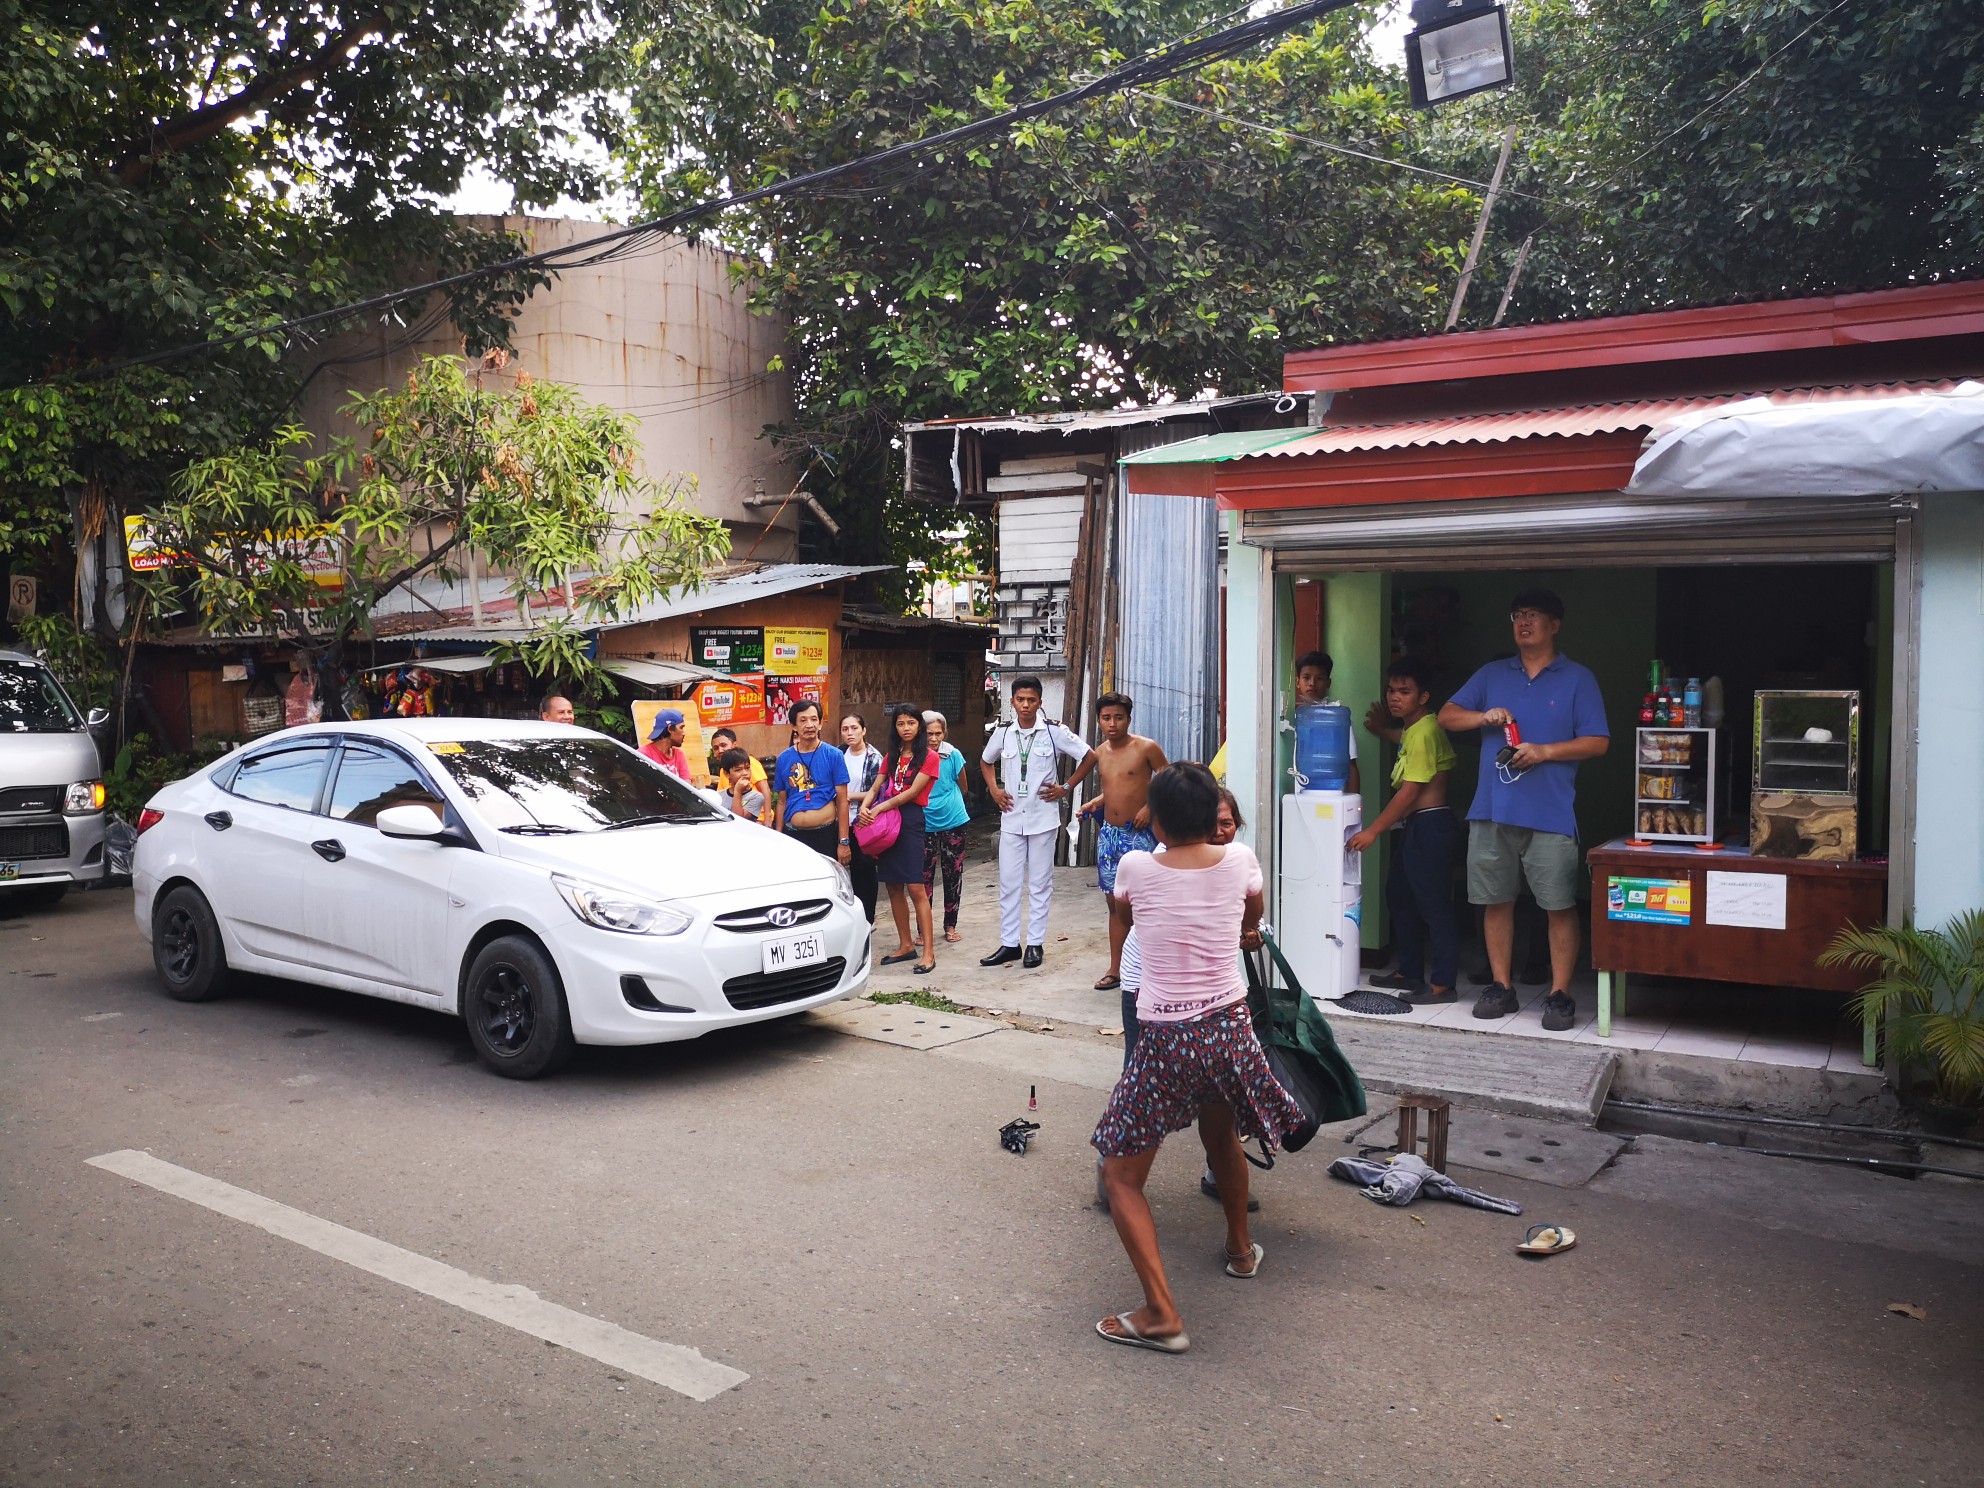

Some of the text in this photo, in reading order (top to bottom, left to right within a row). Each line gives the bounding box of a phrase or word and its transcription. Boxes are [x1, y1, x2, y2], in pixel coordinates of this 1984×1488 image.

[704, 638, 717, 647] FREE
[774, 636, 786, 644] FREE
[702, 685, 718, 694] FREE
[714, 695, 730, 704] YouTube
[1650, 894, 1666, 903] TNT
[770, 938, 819, 965] MV 3251
